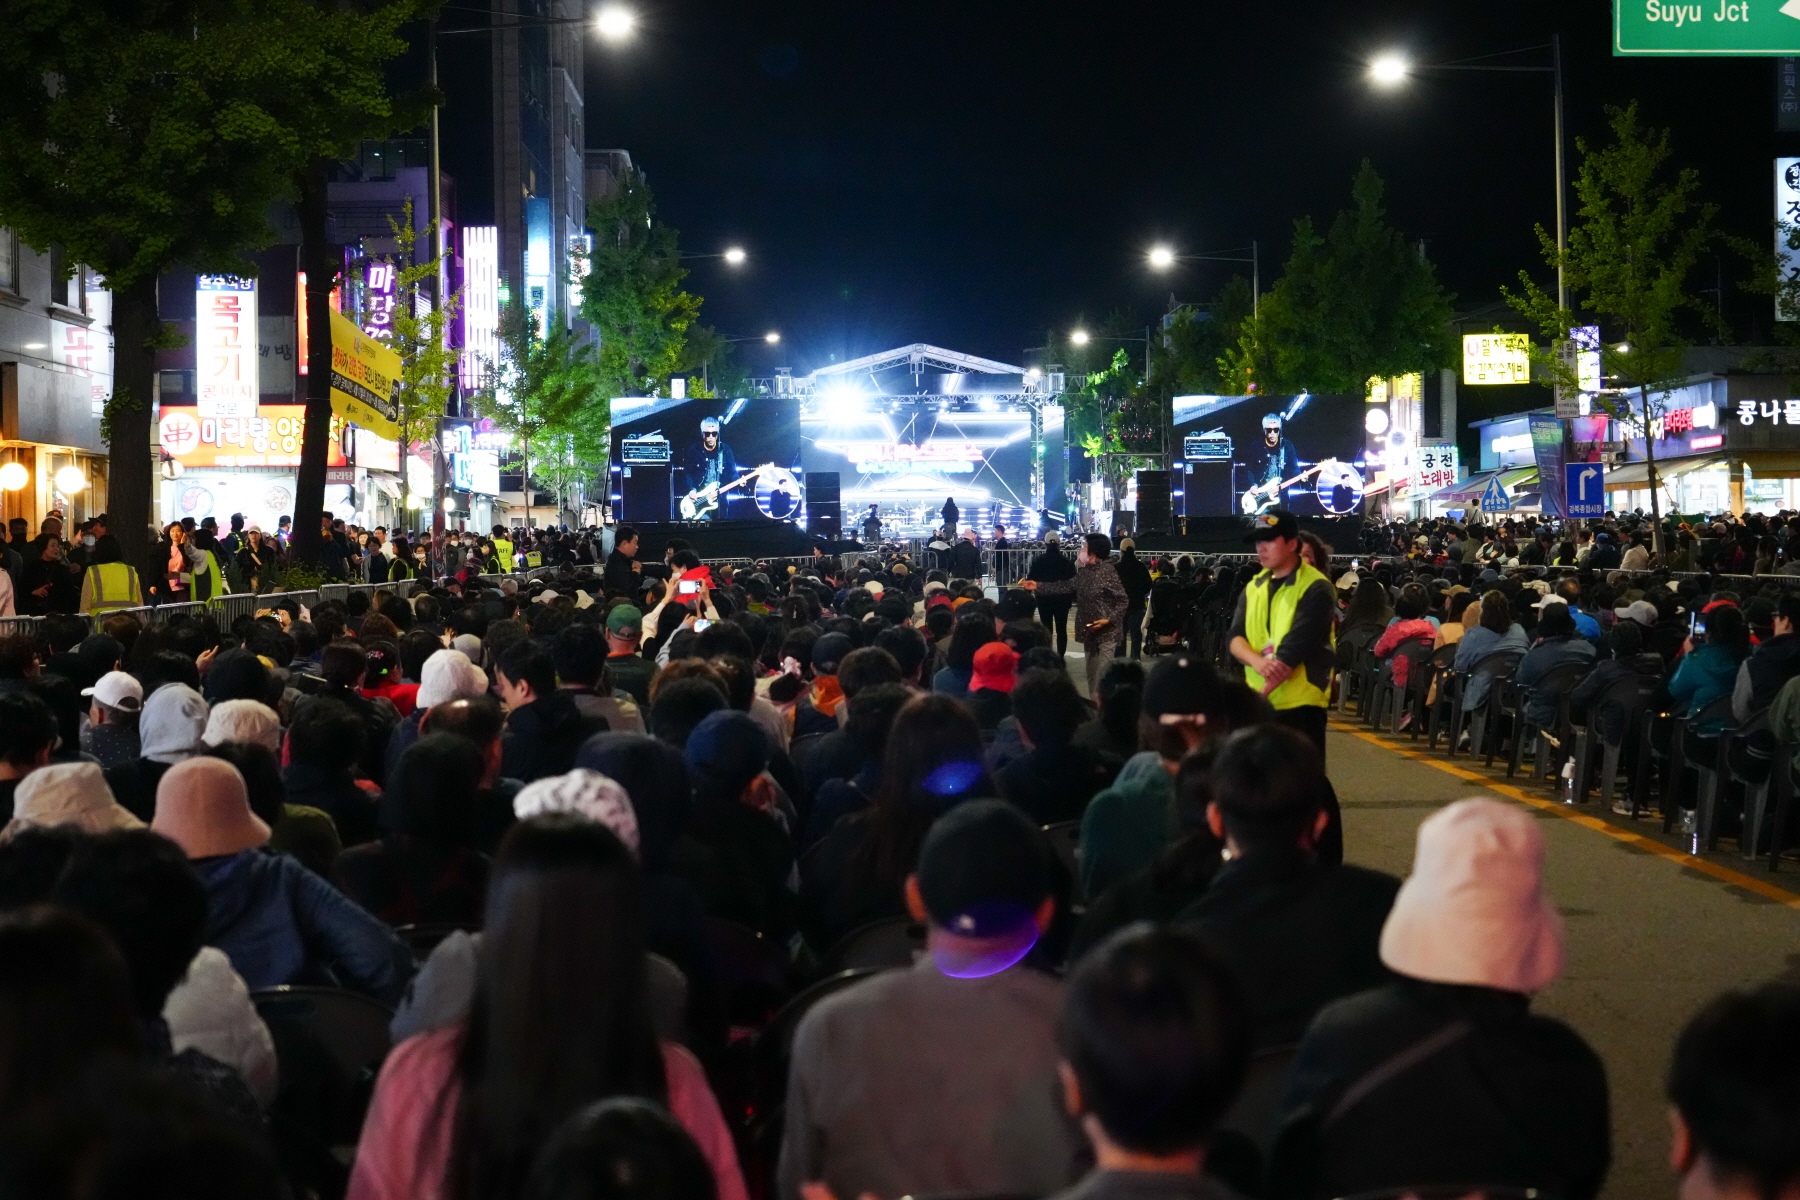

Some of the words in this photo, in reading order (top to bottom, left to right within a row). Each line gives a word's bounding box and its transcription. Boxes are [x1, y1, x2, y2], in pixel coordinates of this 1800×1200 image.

[1646, 0, 1702, 28] Suyu
[1714, 0, 1749, 22] Jct
[212, 296, 242, 381] 목고기
[163, 419, 193, 447] 串
[1422, 453, 1453, 468] 궁전
[1420, 469, 1454, 487] 노래방
[1568, 504, 1603, 514] 강북종합시장
